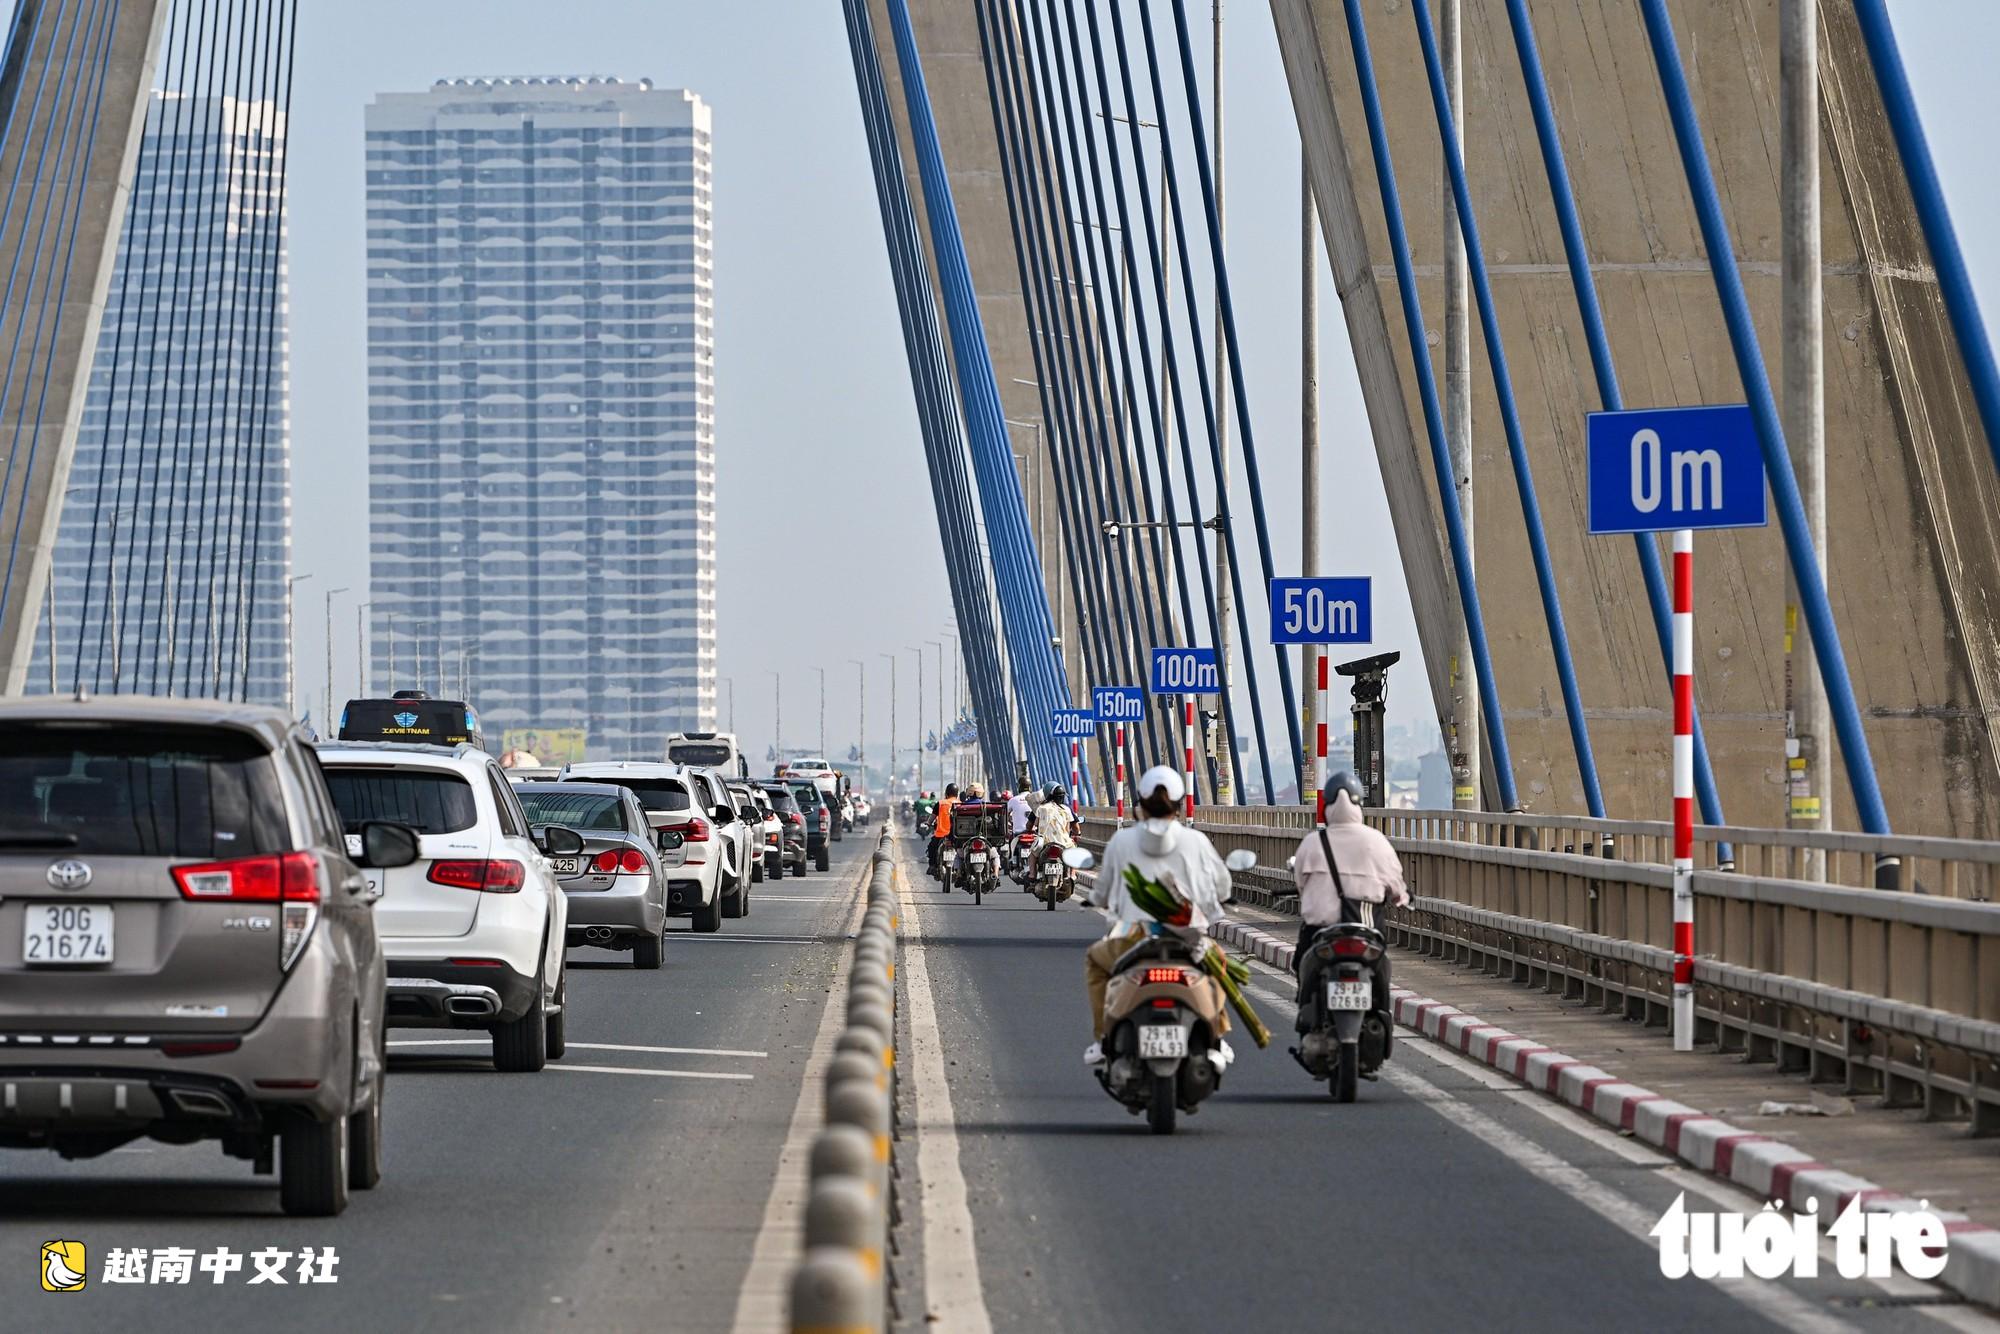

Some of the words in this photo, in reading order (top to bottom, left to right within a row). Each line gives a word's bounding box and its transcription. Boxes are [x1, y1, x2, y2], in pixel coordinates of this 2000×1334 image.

[1631, 428, 1723, 513] 0m
[1284, 587, 1358, 634] 50m
[1156, 654, 1219, 688] 100m
[1096, 691, 1141, 718] 150m
[1054, 713, 1094, 735] 200m
[46, 907, 92, 931] 30G
[28, 934, 107, 959] 216.74
